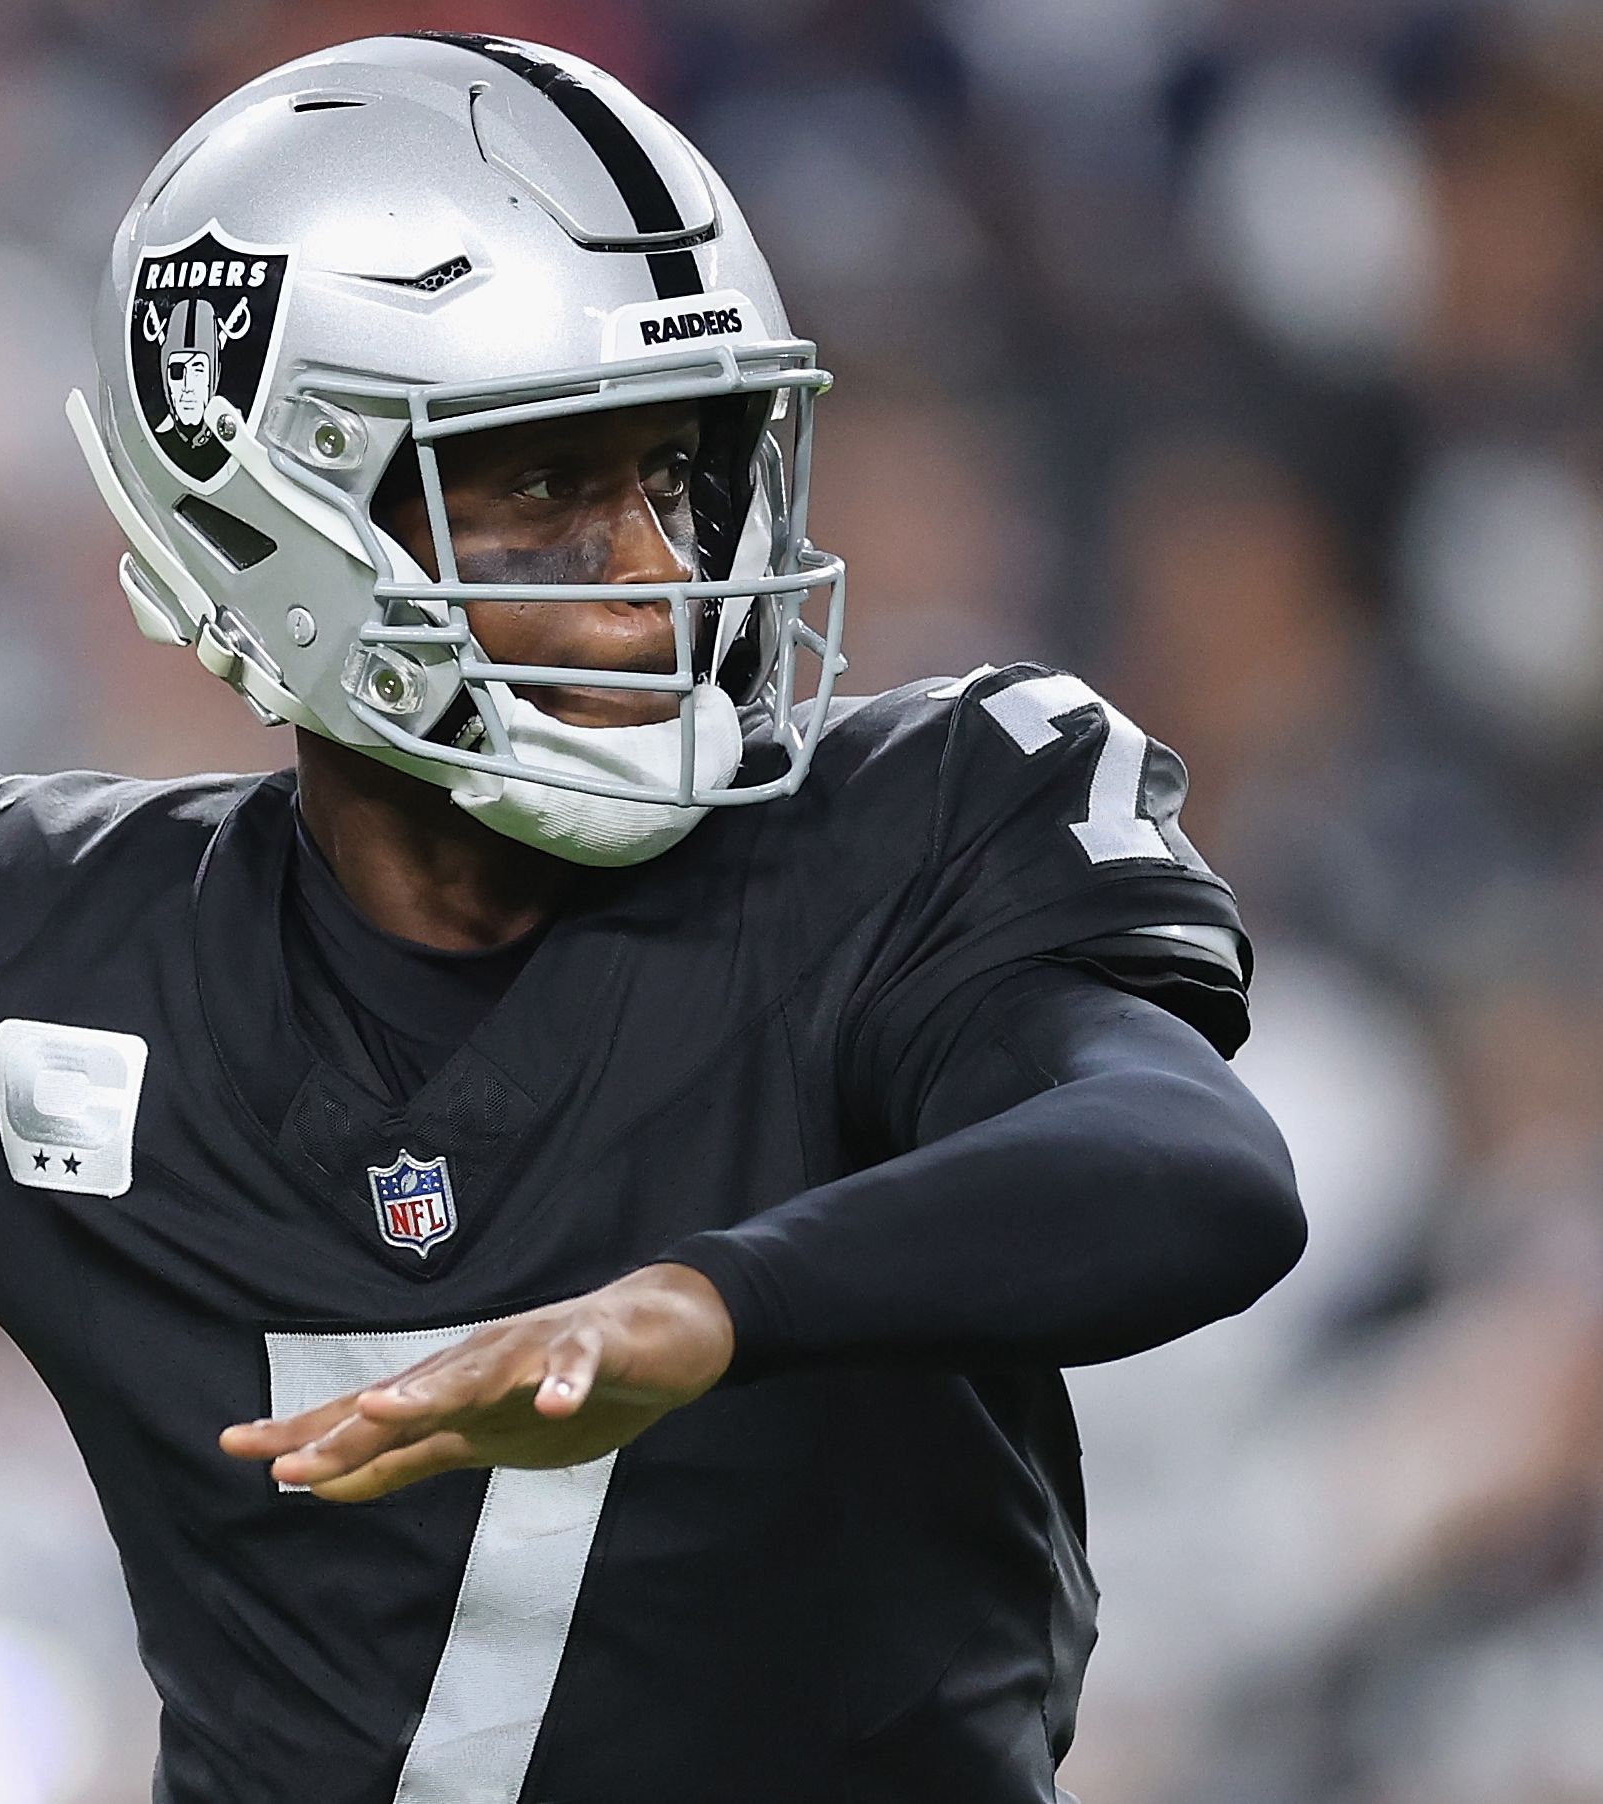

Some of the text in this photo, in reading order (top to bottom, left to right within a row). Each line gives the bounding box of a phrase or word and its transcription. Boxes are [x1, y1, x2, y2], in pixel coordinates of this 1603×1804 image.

[145, 261, 269, 290] RAIDERS
[639, 307, 743, 346] RAIDERS
[980, 674, 1175, 865] 7
[4, 1038, 128, 1150] C
[386, 1198, 445, 1238] NFL
